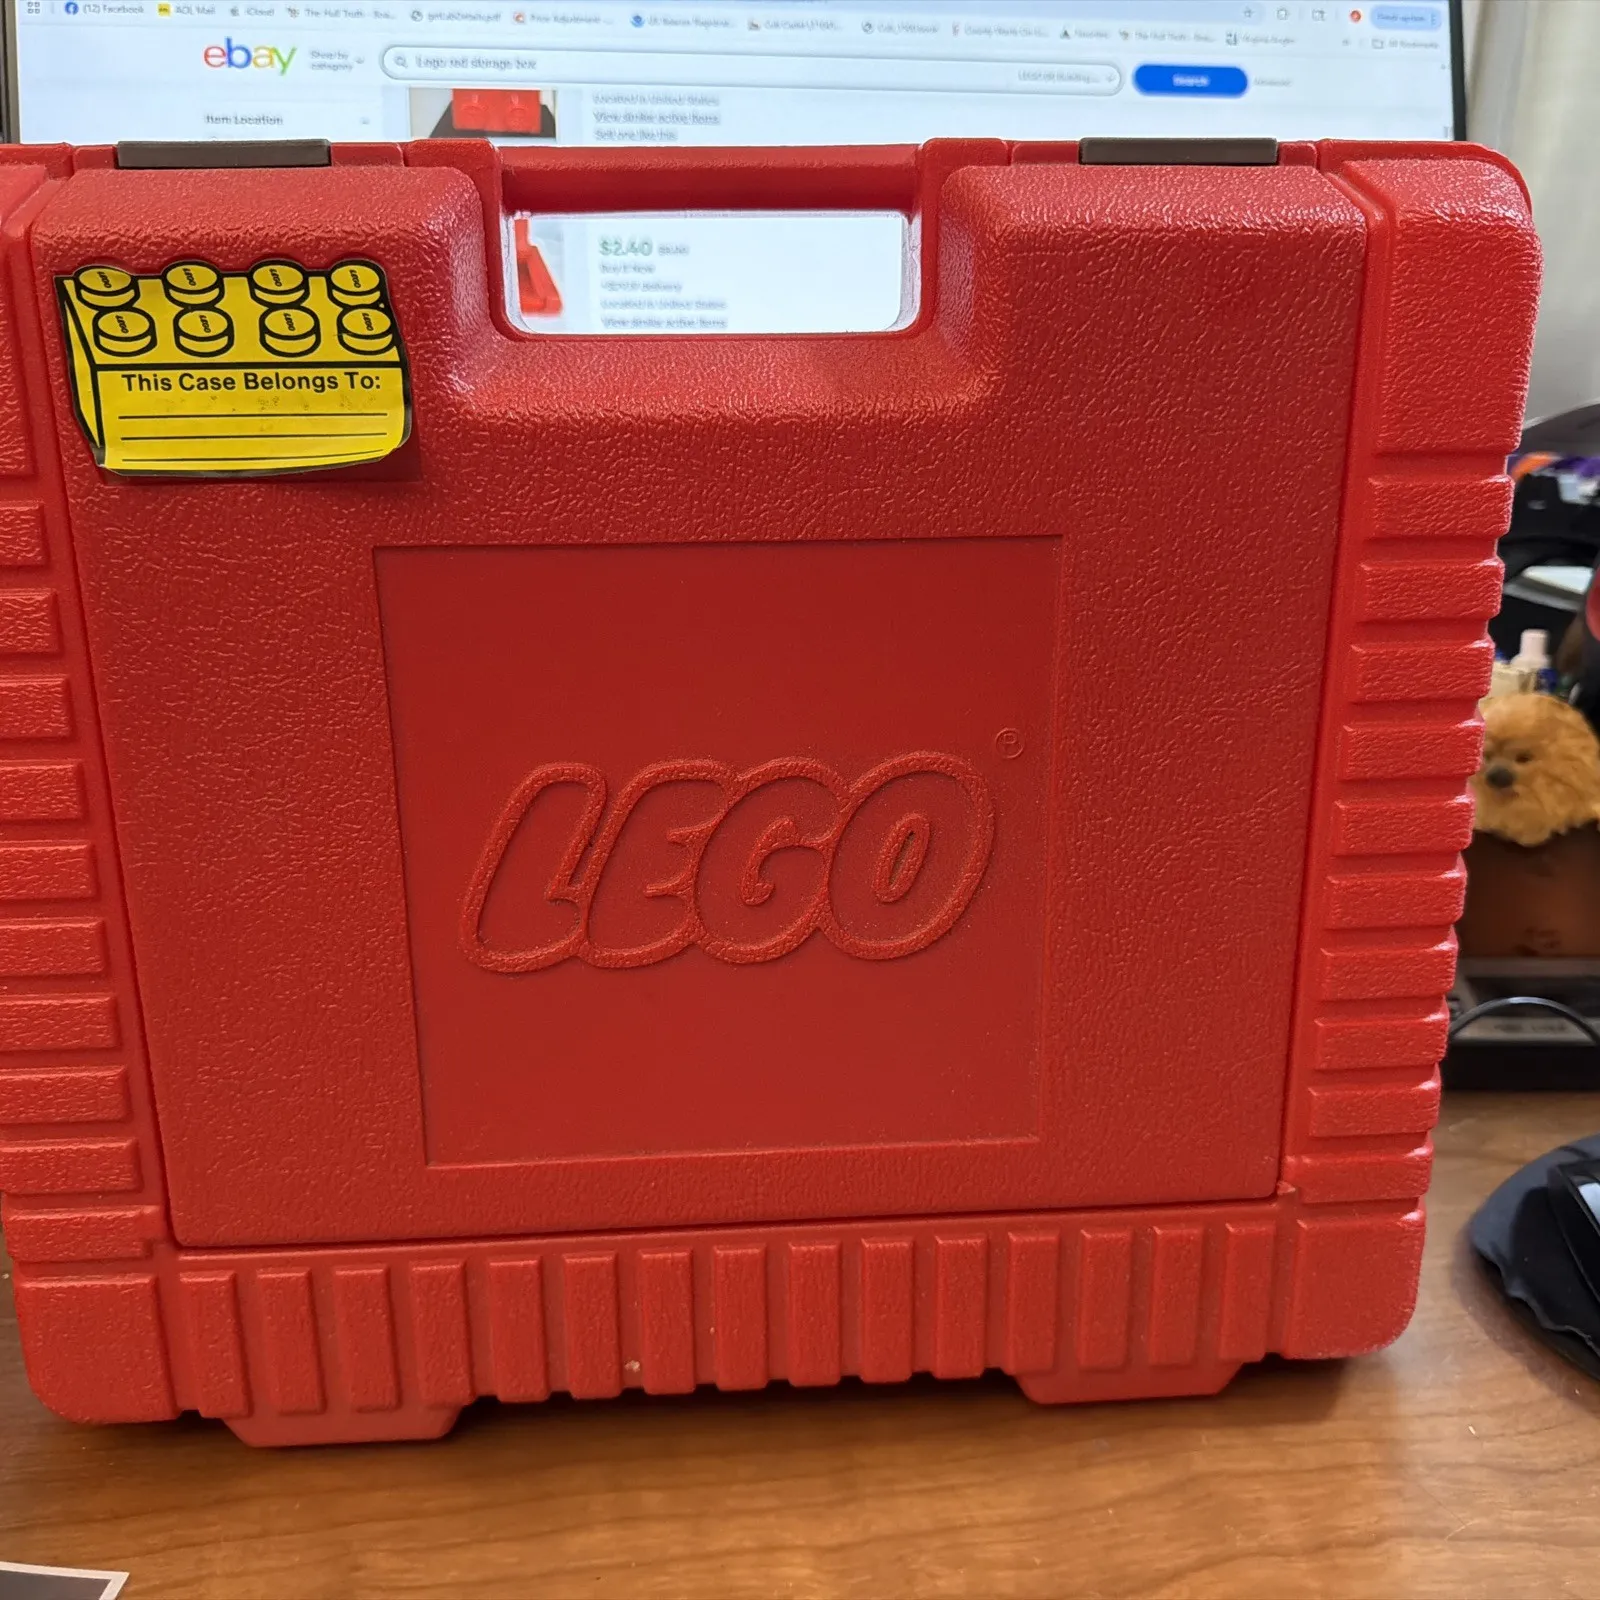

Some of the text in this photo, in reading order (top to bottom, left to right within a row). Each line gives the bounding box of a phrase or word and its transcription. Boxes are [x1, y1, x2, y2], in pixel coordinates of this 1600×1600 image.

[83, 3, 101, 15] (12)
[103, 4, 145, 15] Facebook
[203, 37, 298, 76] ebay
[205, 113, 284, 127] Item Location
[599, 237, 653, 257] $2.40
[97, 271, 112, 288] LEGO
[182, 268, 196, 286] LEGO
[269, 268, 283, 287] LEGO
[349, 269, 361, 288] LEGO
[115, 315, 129, 334] LEGO
[199, 314, 211, 334] LEGO
[283, 312, 296, 332] LEGO
[362, 312, 374, 332] LEGO
[121, 371, 381, 394] This Case Belongs To:
[459, 748, 995, 974] LEGO
